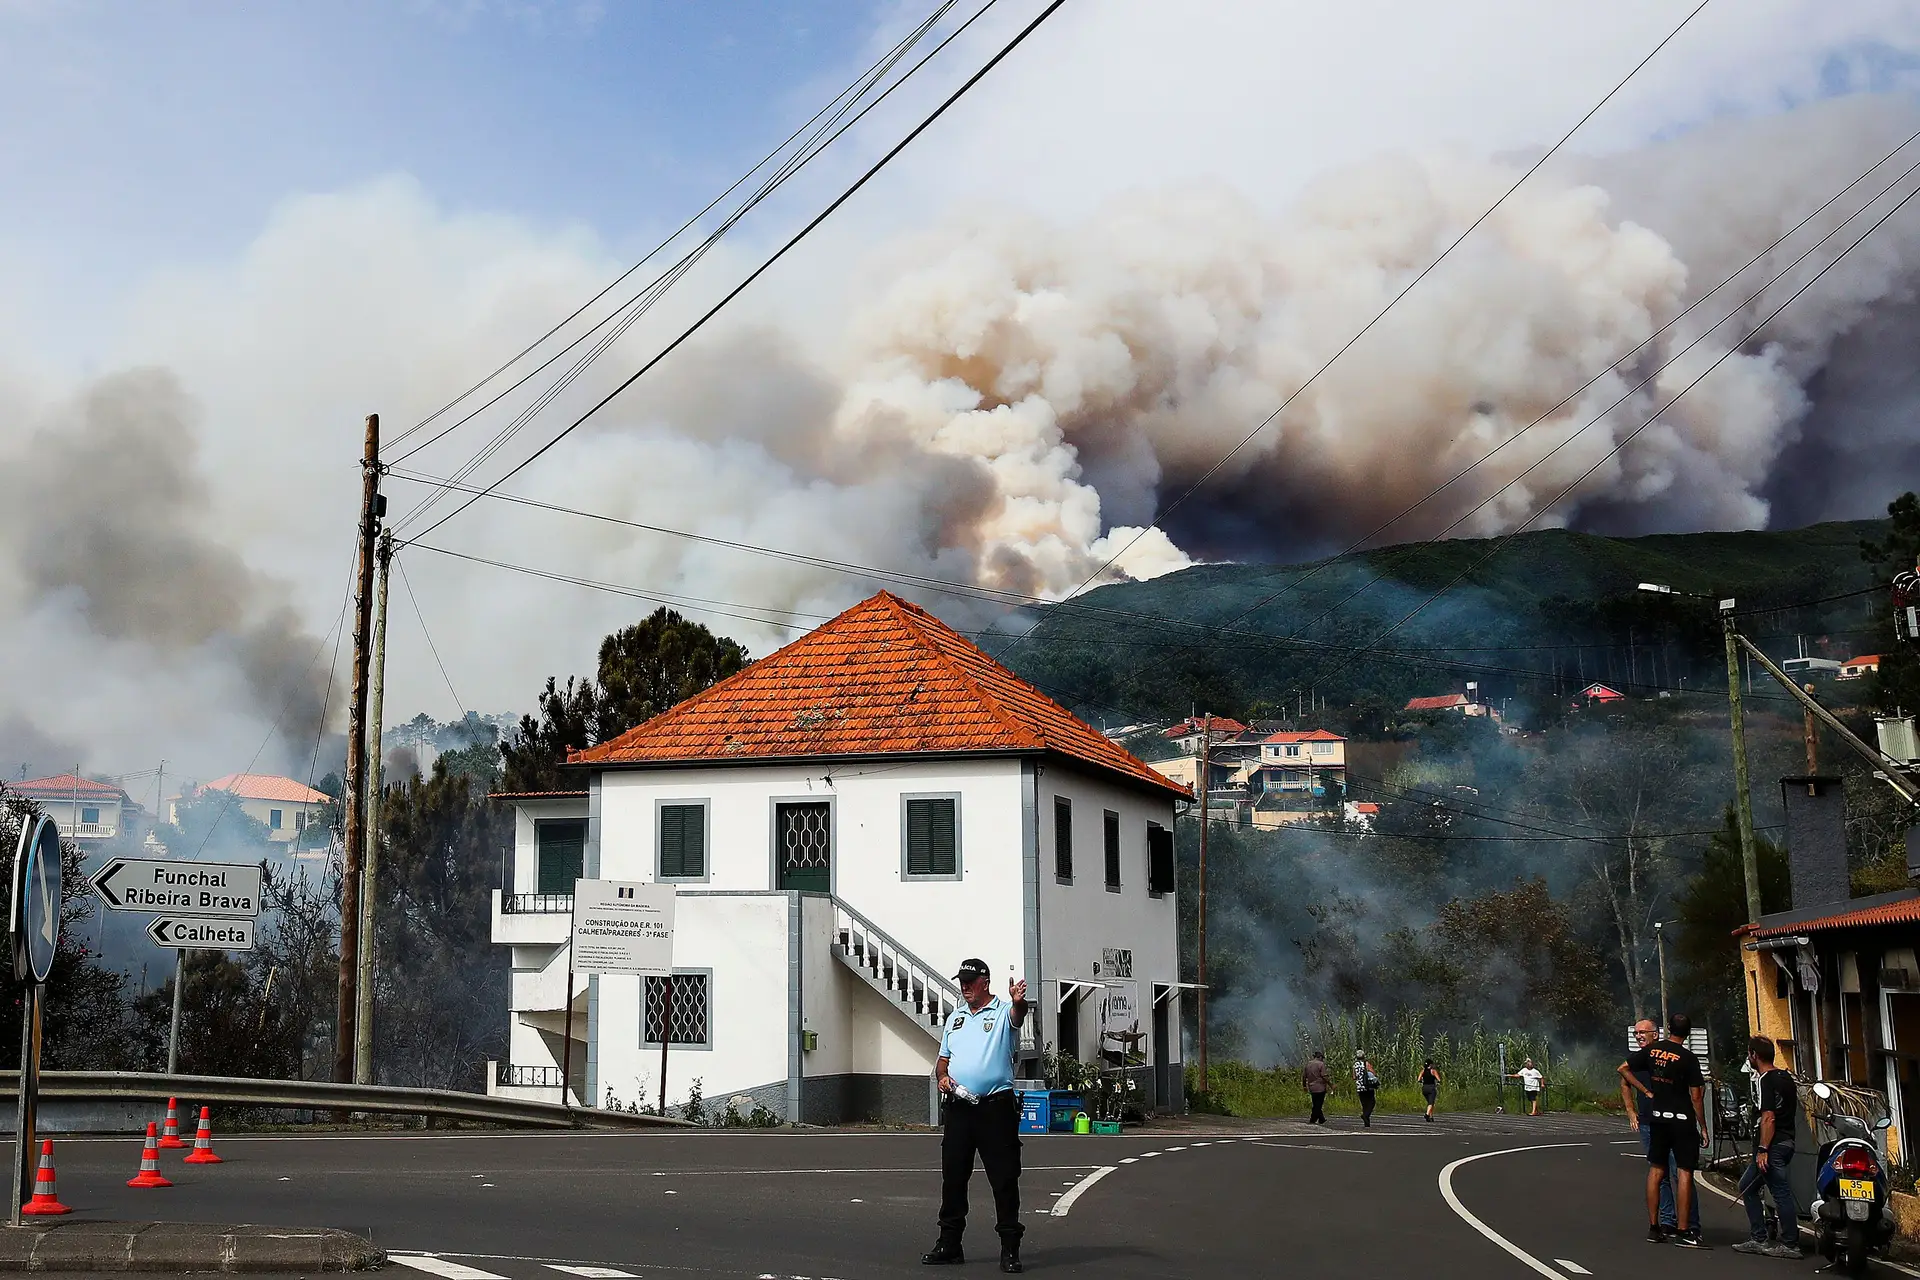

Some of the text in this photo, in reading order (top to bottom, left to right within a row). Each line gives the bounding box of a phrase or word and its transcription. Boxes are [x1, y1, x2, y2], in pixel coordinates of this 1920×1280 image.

[154, 868, 227, 887] Funchal
[125, 888, 251, 909] Ribeira Brava
[585, 919, 628, 928] CONSTRUÇÃO
[174, 924, 245, 942] Calheta
[960, 964, 976, 972] LÍCIA
[1650, 1049, 1680, 1062] STAFF
[1850, 1180, 1862, 1189] 35
[1861, 1190, 1872, 1199] 01
